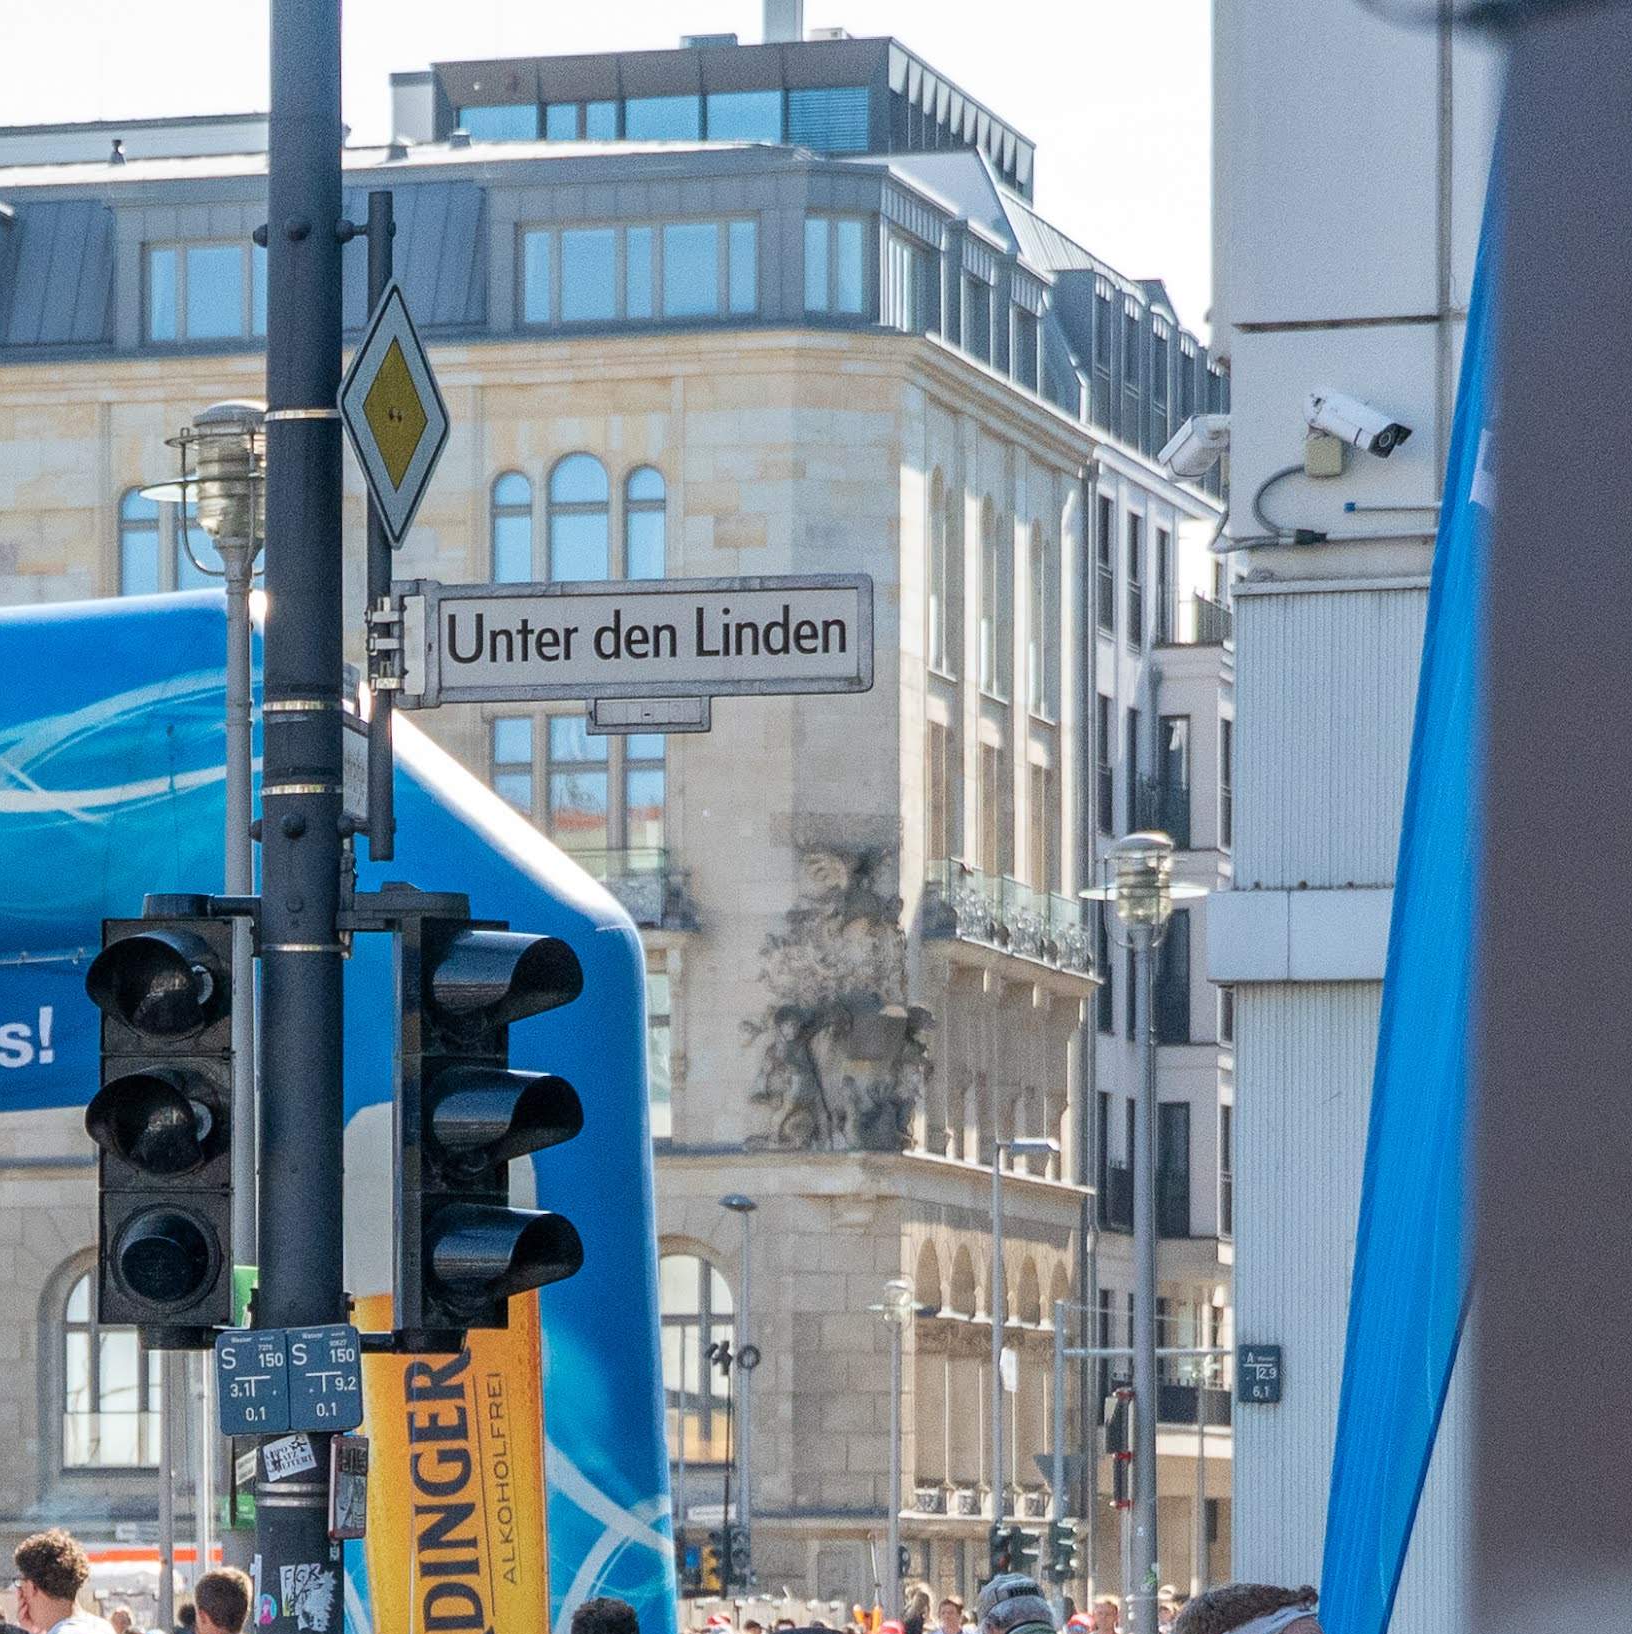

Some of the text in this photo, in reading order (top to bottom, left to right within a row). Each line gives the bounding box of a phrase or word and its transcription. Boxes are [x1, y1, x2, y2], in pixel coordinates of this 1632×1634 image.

[447, 604, 847, 664] Unter den Linden
[221, 1347, 284, 1370] S 150
[291, 1343, 355, 1366] S 150
[245, 1406, 266, 1421] 0.1
[316, 1402, 337, 1417] 0.1
[487, 1371, 519, 1585] ALKOHOLFREI
